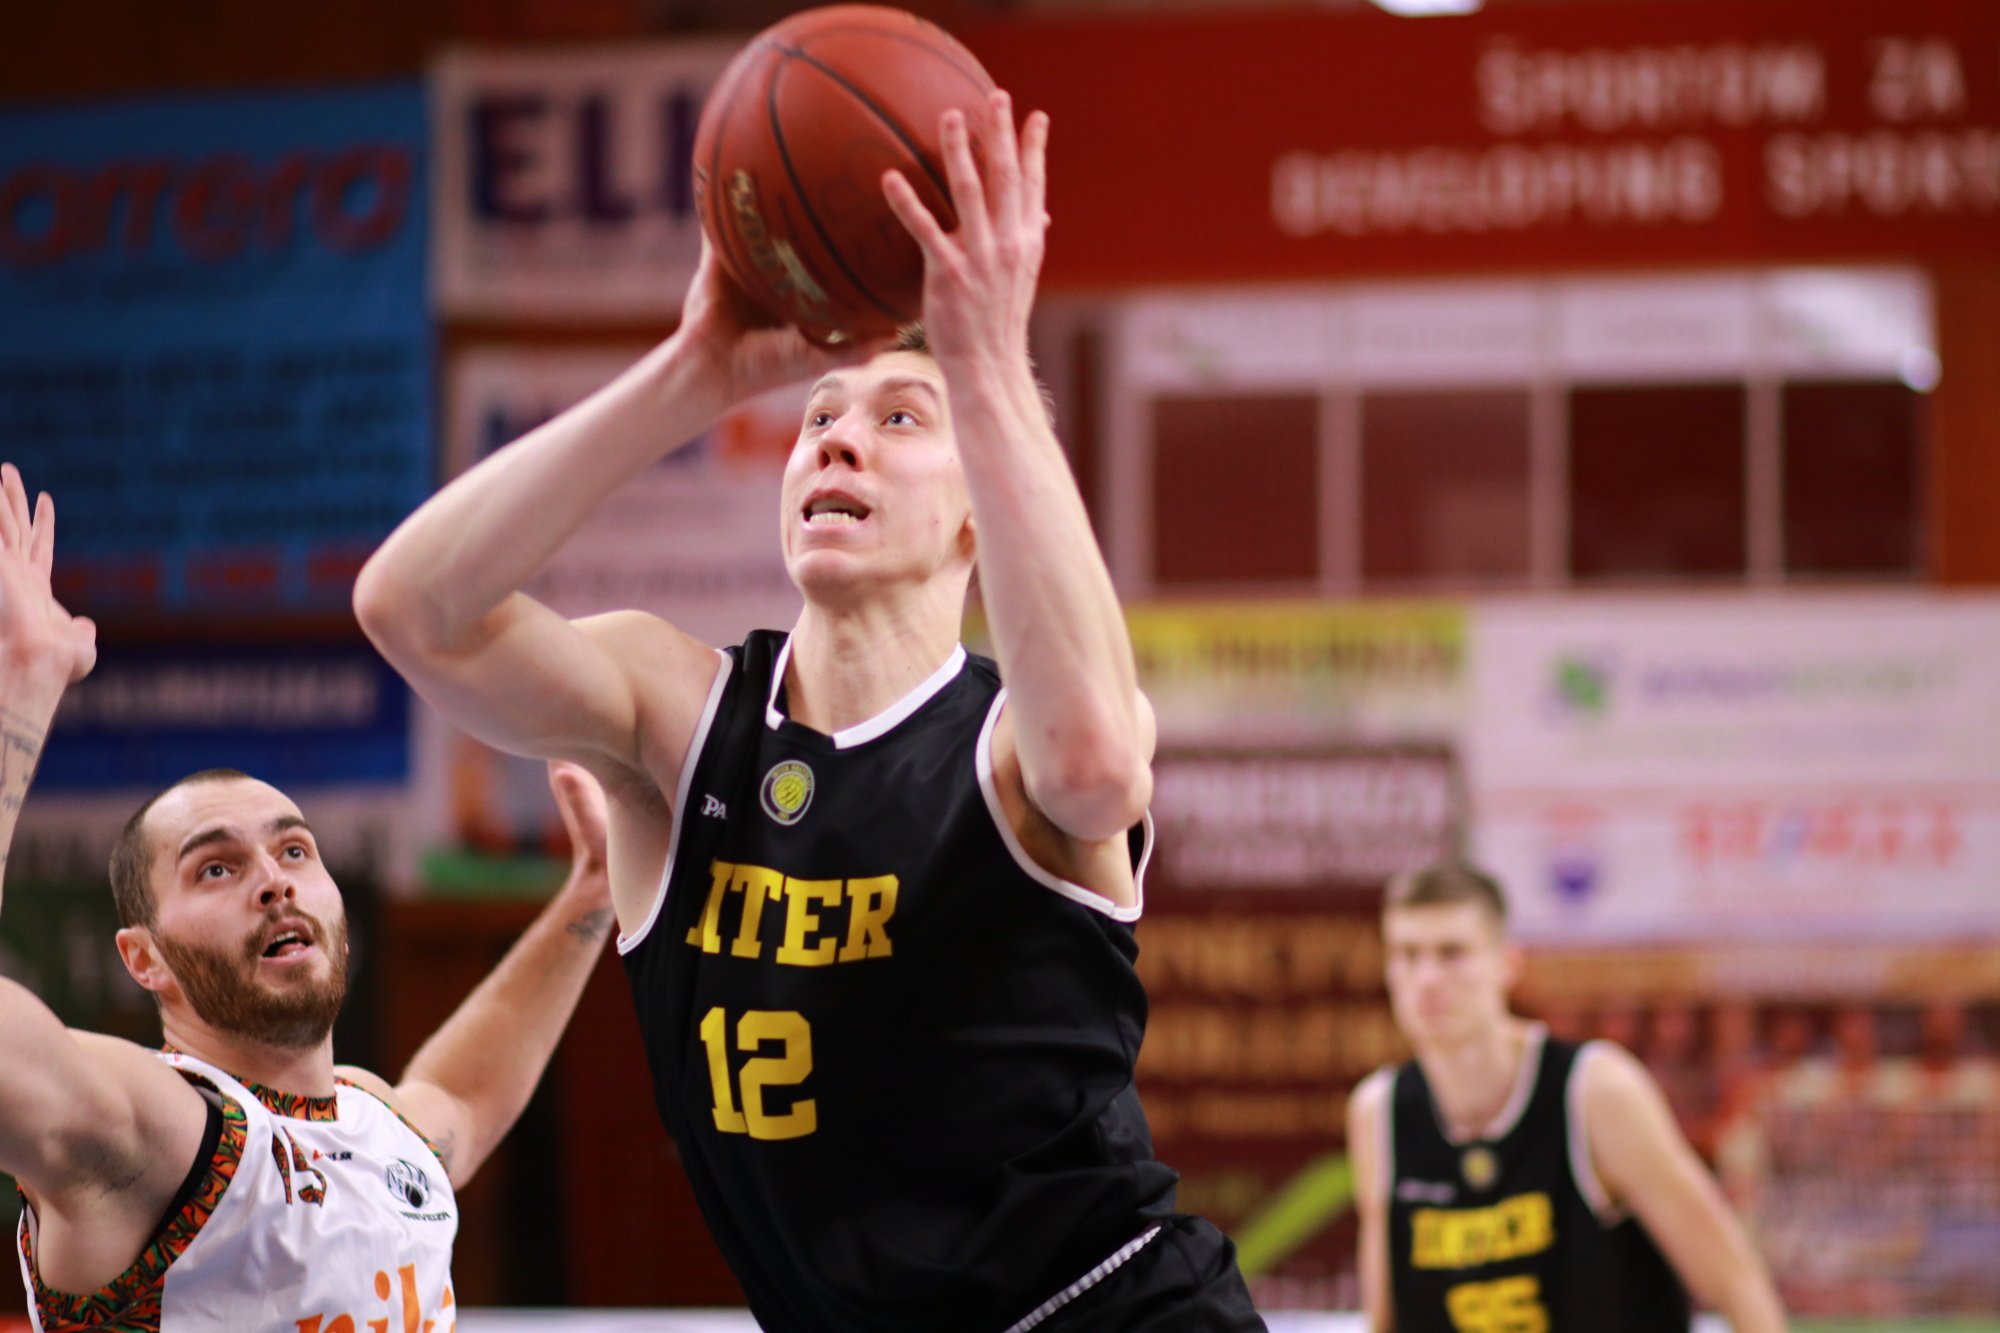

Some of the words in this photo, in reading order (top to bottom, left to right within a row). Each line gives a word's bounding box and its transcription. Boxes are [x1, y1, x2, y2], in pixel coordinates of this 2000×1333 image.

[1870, 40, 1965, 120] ZA
[1272, 136, 1721, 236] DEVELOPING
[701, 1007, 817, 1140] 12
[272, 1126, 327, 1208] 15
